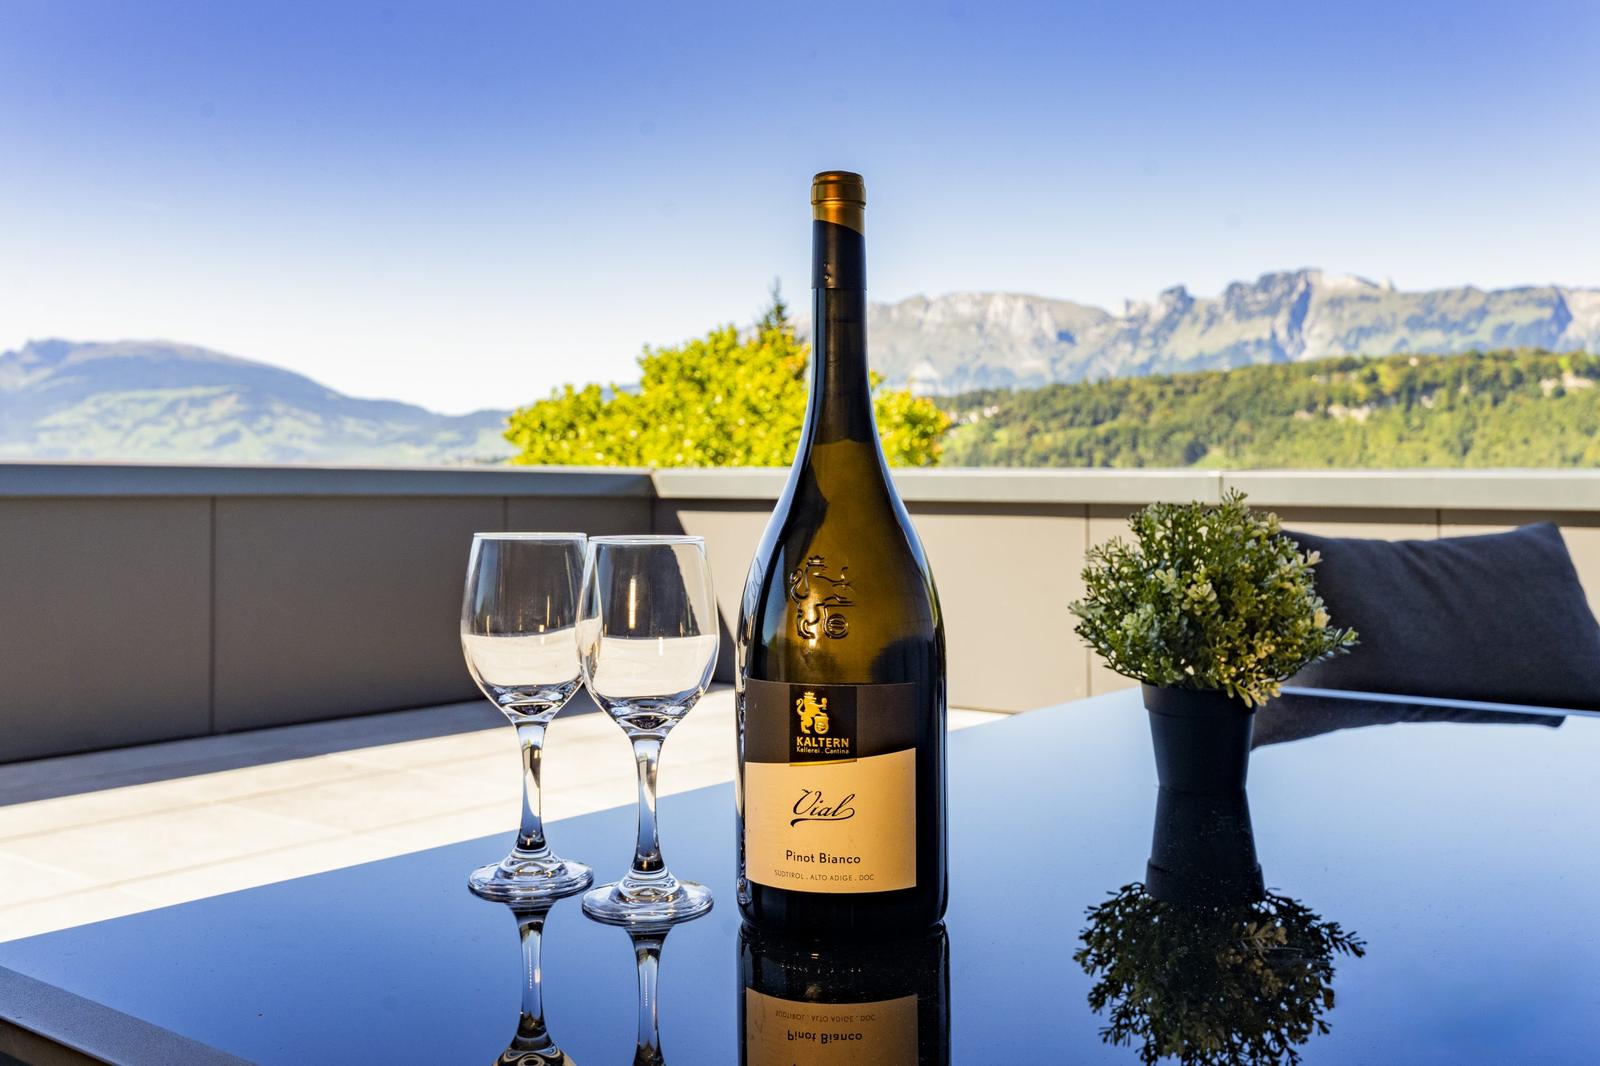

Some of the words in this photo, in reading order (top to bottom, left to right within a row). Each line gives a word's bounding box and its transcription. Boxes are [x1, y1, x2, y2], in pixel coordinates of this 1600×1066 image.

[796, 736, 849, 748] KALTERN
[796, 746, 820, 754] Kellerei
[790, 788, 855, 827] Vial
[786, 849, 815, 863] Pinot
[819, 852, 861, 864] Bianco
[829, 874, 853, 882] ADIGE
[859, 873, 875, 881] DOC
